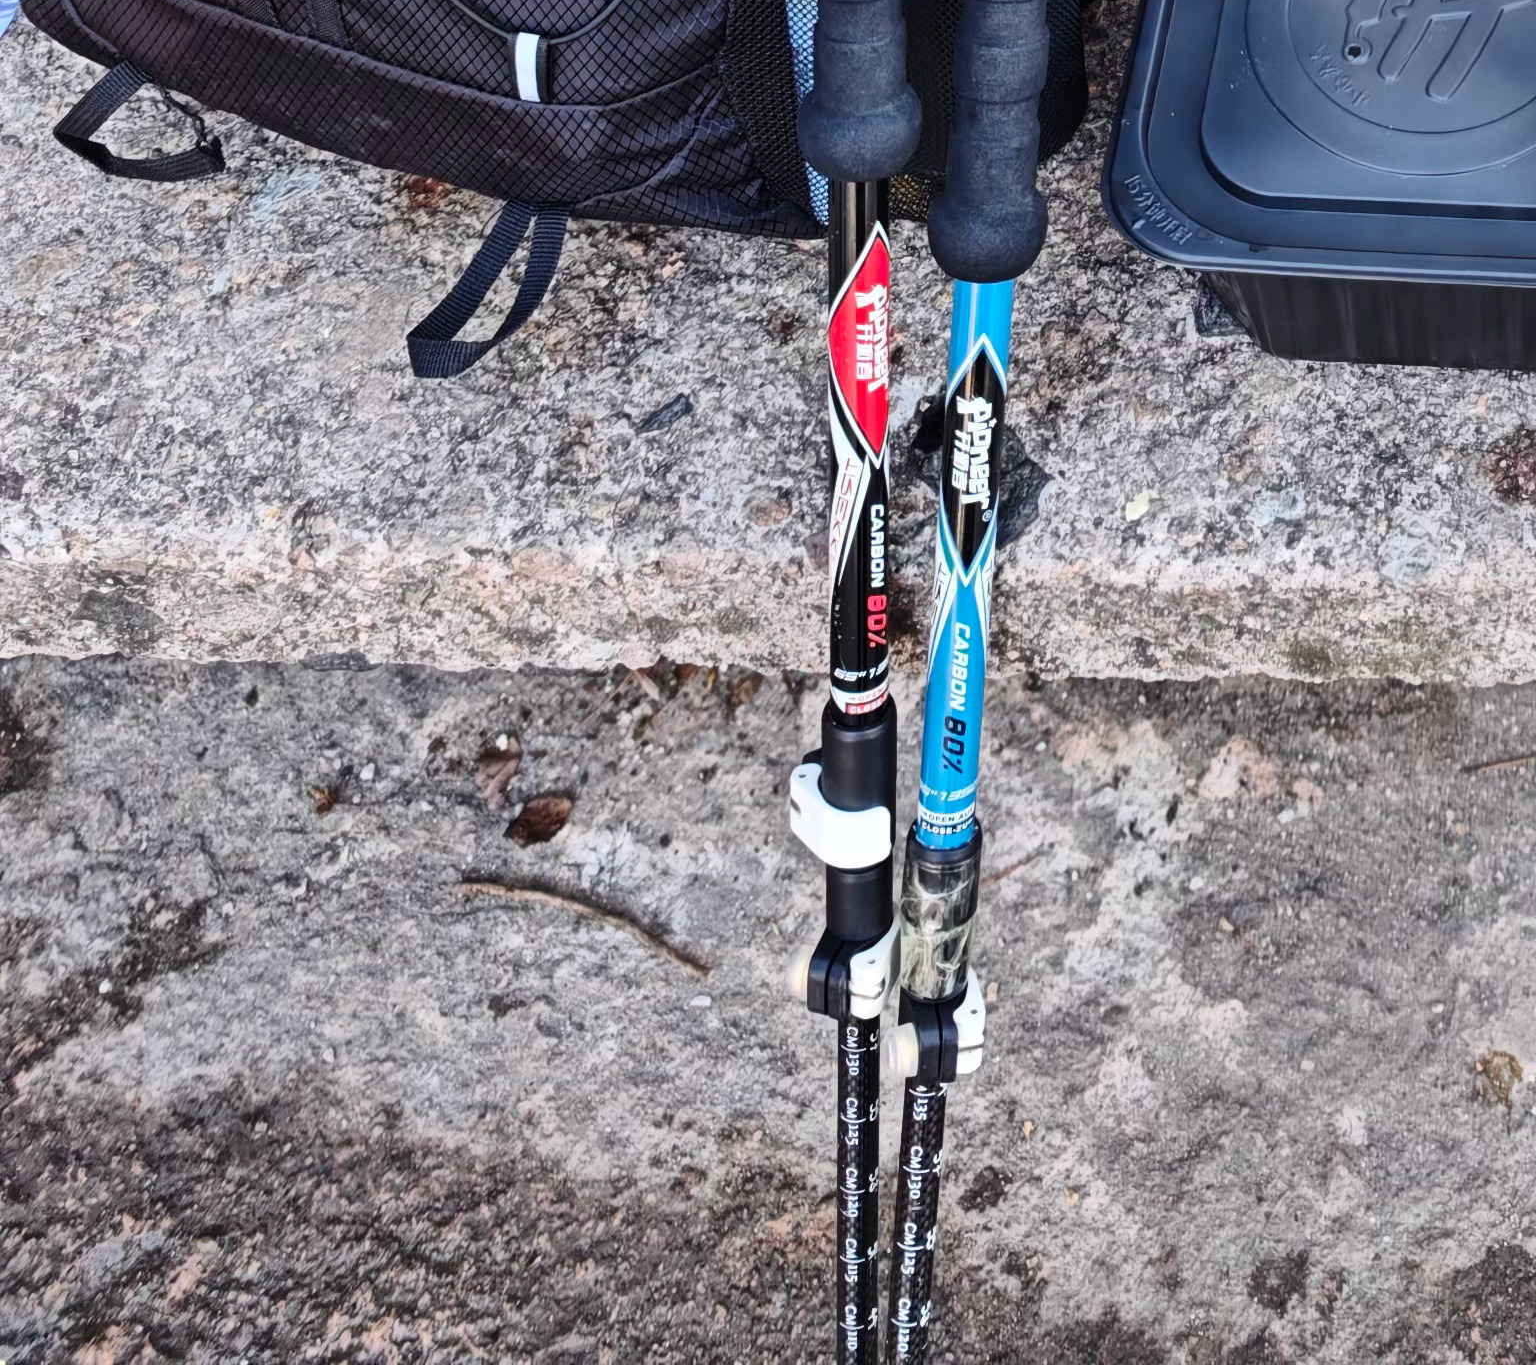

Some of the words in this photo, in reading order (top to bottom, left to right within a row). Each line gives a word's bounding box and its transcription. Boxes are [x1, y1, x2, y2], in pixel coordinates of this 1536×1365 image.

[870, 503, 885, 589] CARBON
[867, 594, 887, 648] 80%
[950, 621, 971, 712] CARBON
[942, 716, 967, 774] 80%
[912, 1098, 928, 1122] 135
